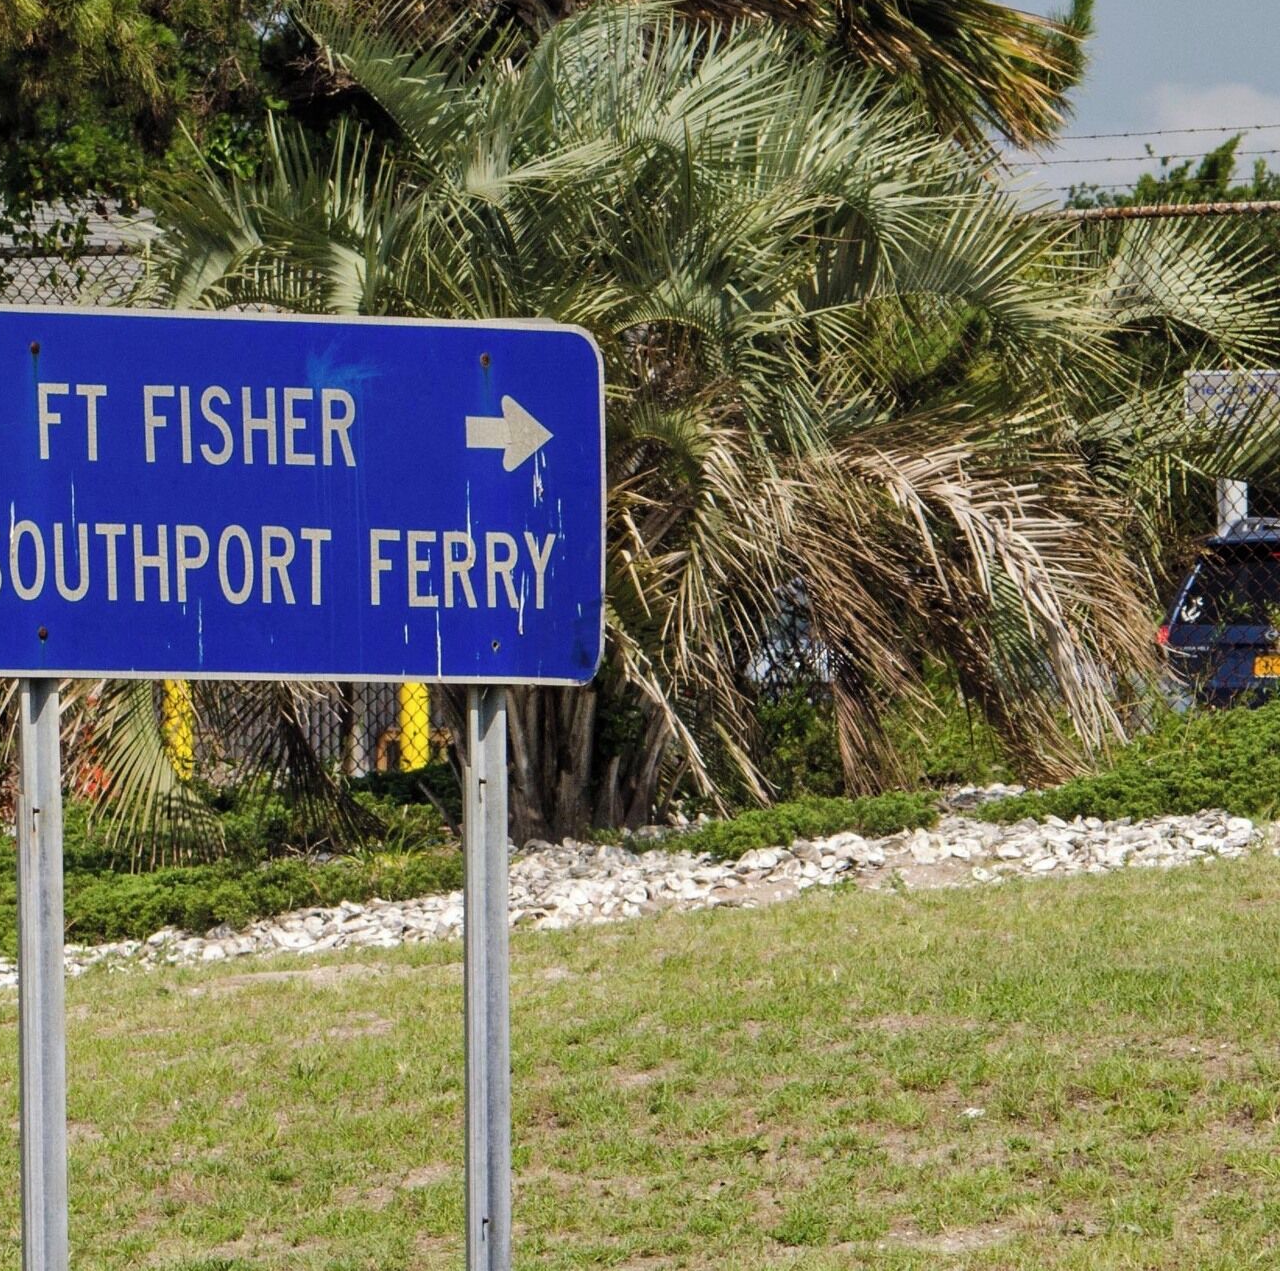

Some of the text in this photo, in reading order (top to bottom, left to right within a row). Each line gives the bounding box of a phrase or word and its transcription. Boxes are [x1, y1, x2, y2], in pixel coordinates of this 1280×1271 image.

[37, 382, 357, 467] FT FISHER
[369, 529, 557, 611] FERRY
